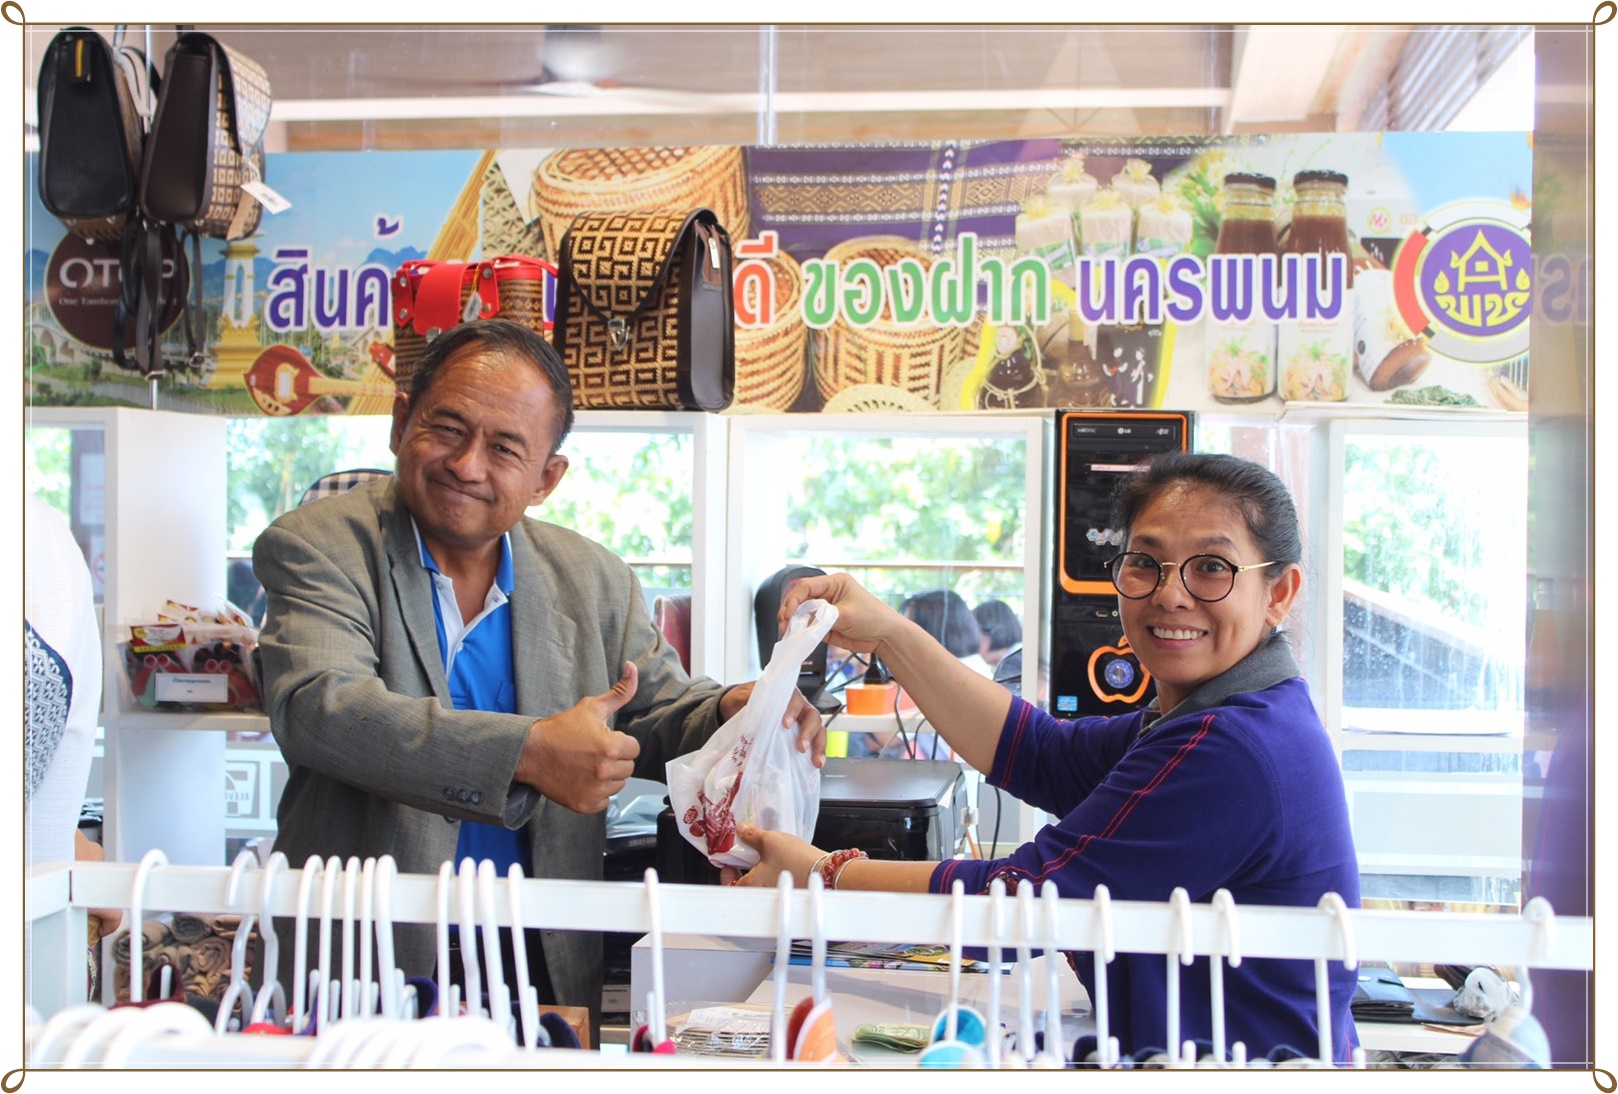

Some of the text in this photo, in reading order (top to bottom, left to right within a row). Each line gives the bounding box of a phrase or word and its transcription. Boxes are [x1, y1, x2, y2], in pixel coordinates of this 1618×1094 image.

[59, 257, 176, 289] OTP
[267, 216, 1344, 330] สินค้ ดี ของฝาก นครพนม
